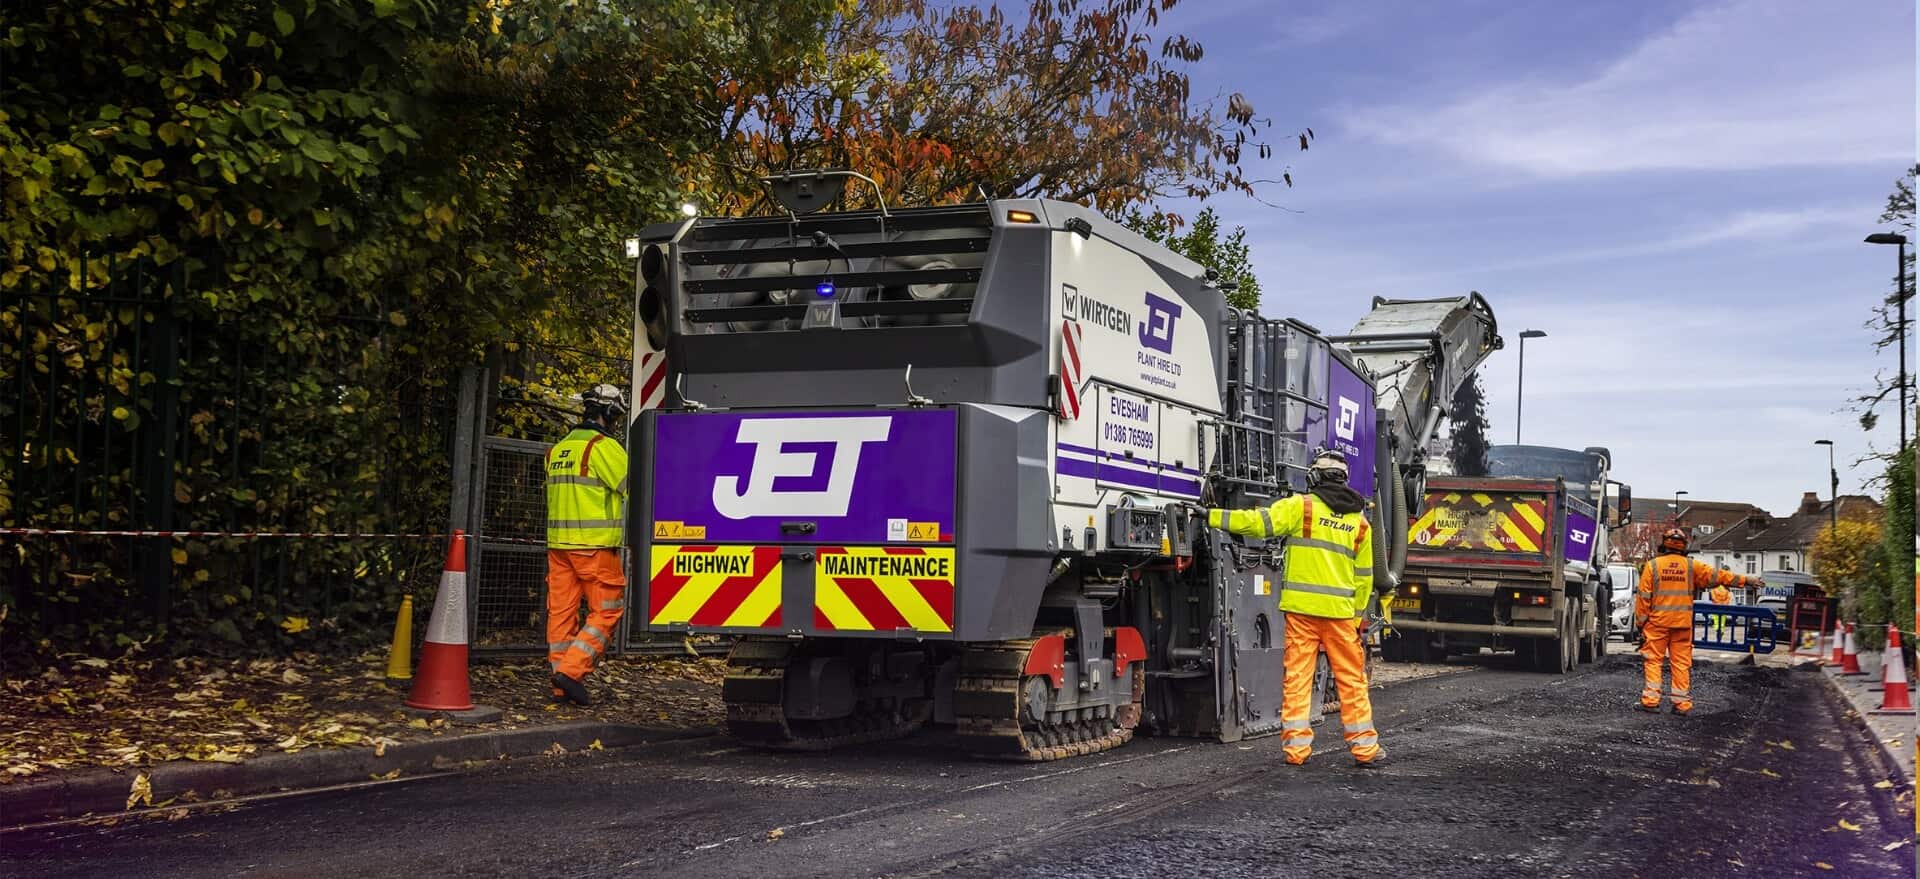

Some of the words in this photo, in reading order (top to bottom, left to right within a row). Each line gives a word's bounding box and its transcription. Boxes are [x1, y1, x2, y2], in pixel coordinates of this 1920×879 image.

[1080, 295, 1131, 336] WIRTGEN
[1138, 291, 1182, 355] JET
[1137, 351, 1156, 368] PLANT
[1157, 358, 1170, 373] HIRE
[1171, 363, 1182, 376] LTD
[1111, 396, 1149, 423] EVESHAM
[1335, 394, 1360, 442] JET
[1104, 422, 1127, 444] 01386
[1128, 427, 1153, 450] 765999
[712, 416, 892, 519] JET
[1319, 517, 1355, 533] TETLAW
[1570, 529, 1590, 544] JET
[676, 555, 750, 574] HIGHWAY
[824, 556, 948, 576] MAINTENANCE
